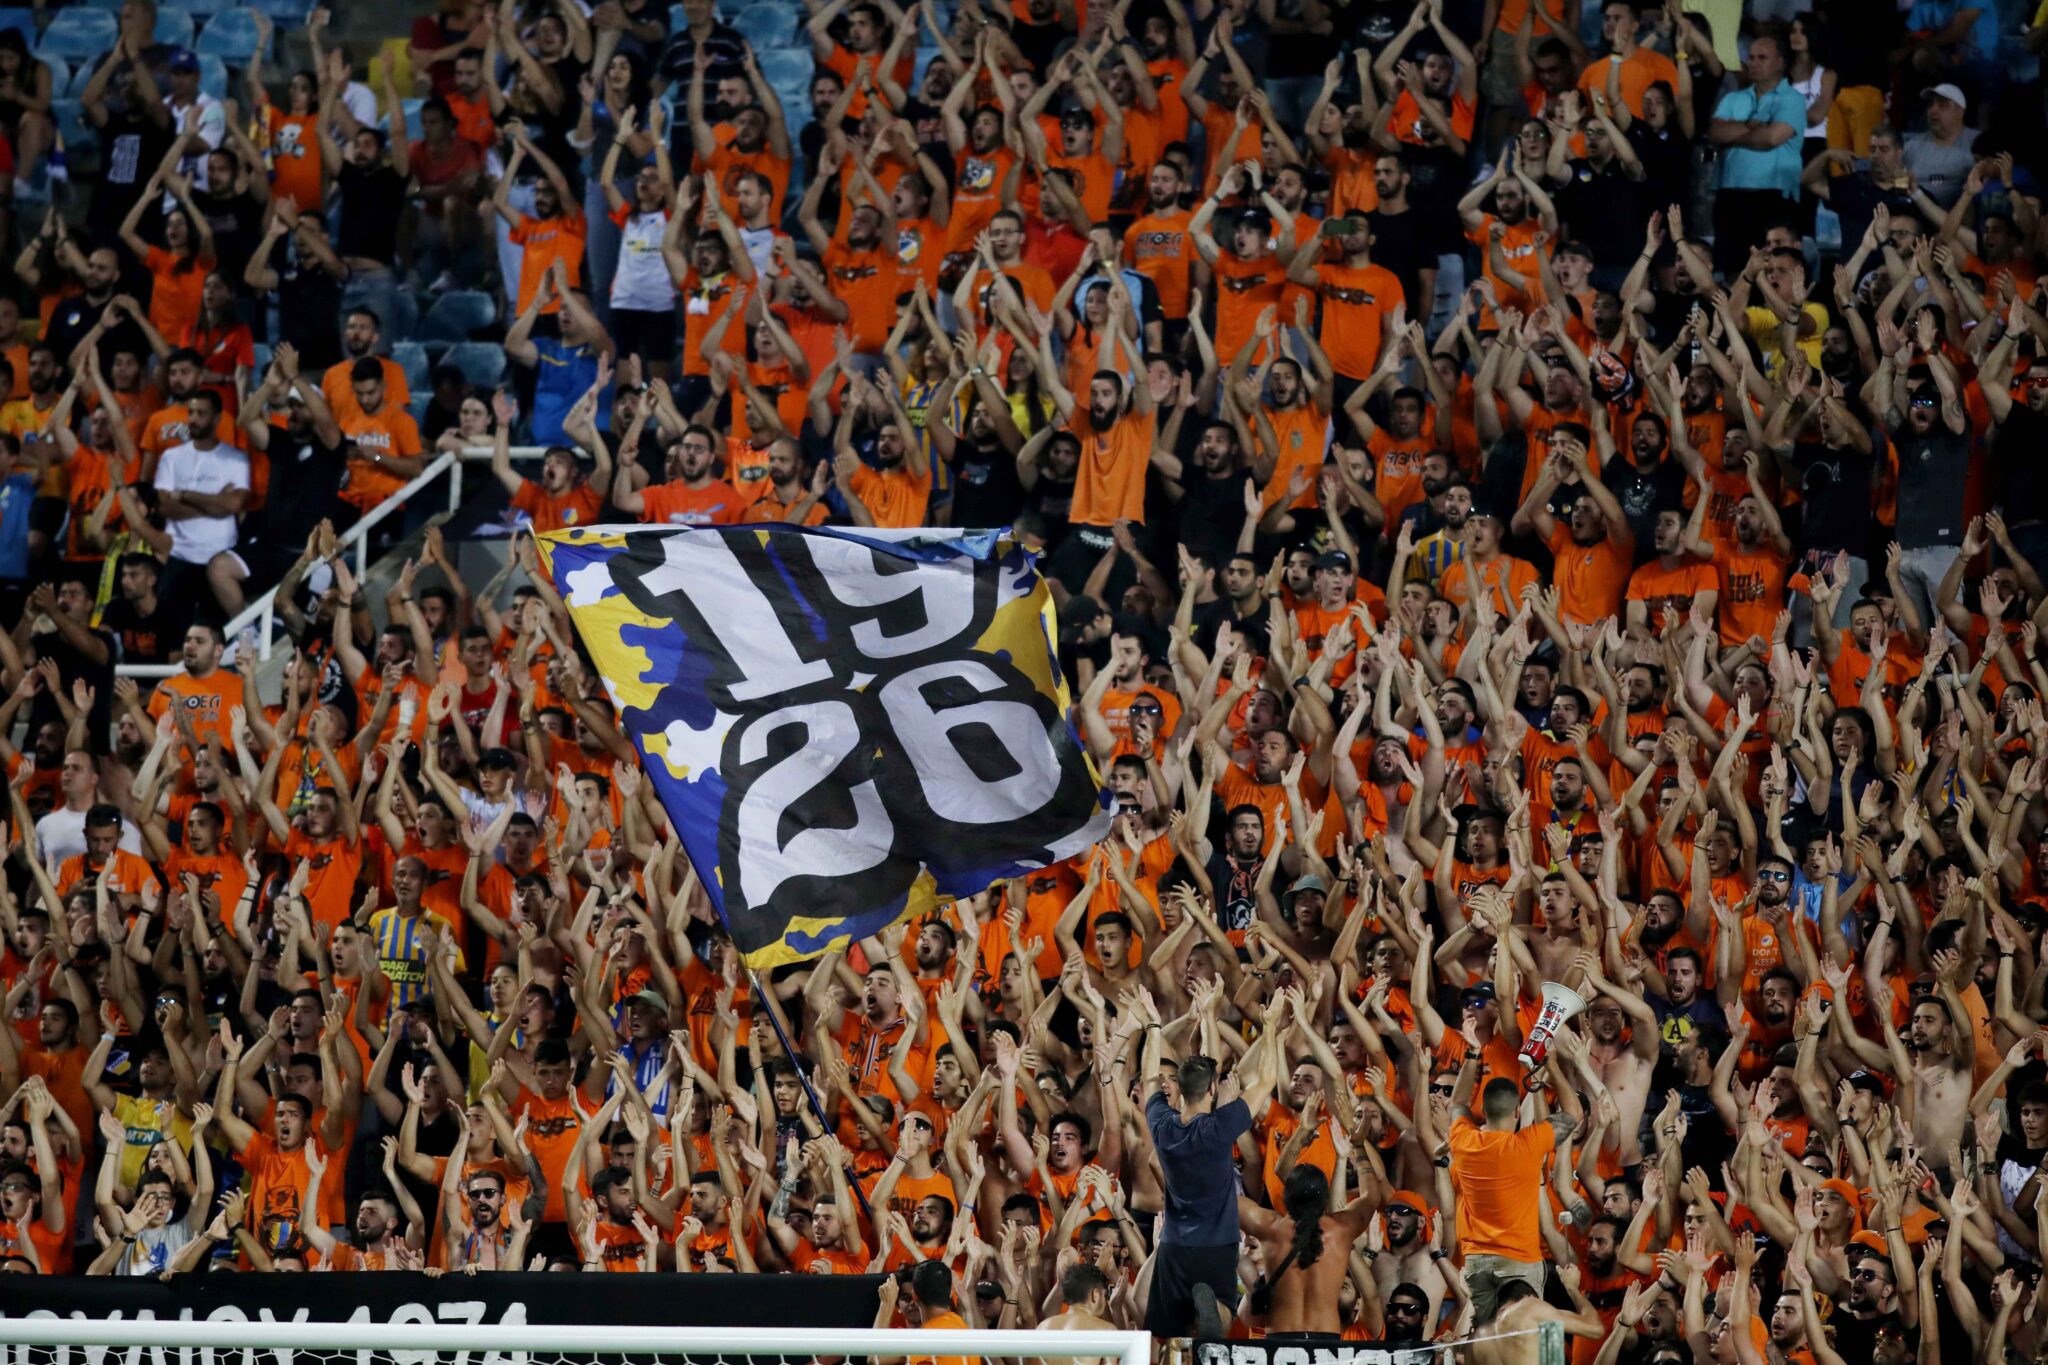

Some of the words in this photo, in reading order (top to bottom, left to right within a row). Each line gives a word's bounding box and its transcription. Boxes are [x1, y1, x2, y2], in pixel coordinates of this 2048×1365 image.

[638, 529, 974, 702] 19
[738, 660, 1061, 910] 26
[383, 960, 410, 971] PARI
